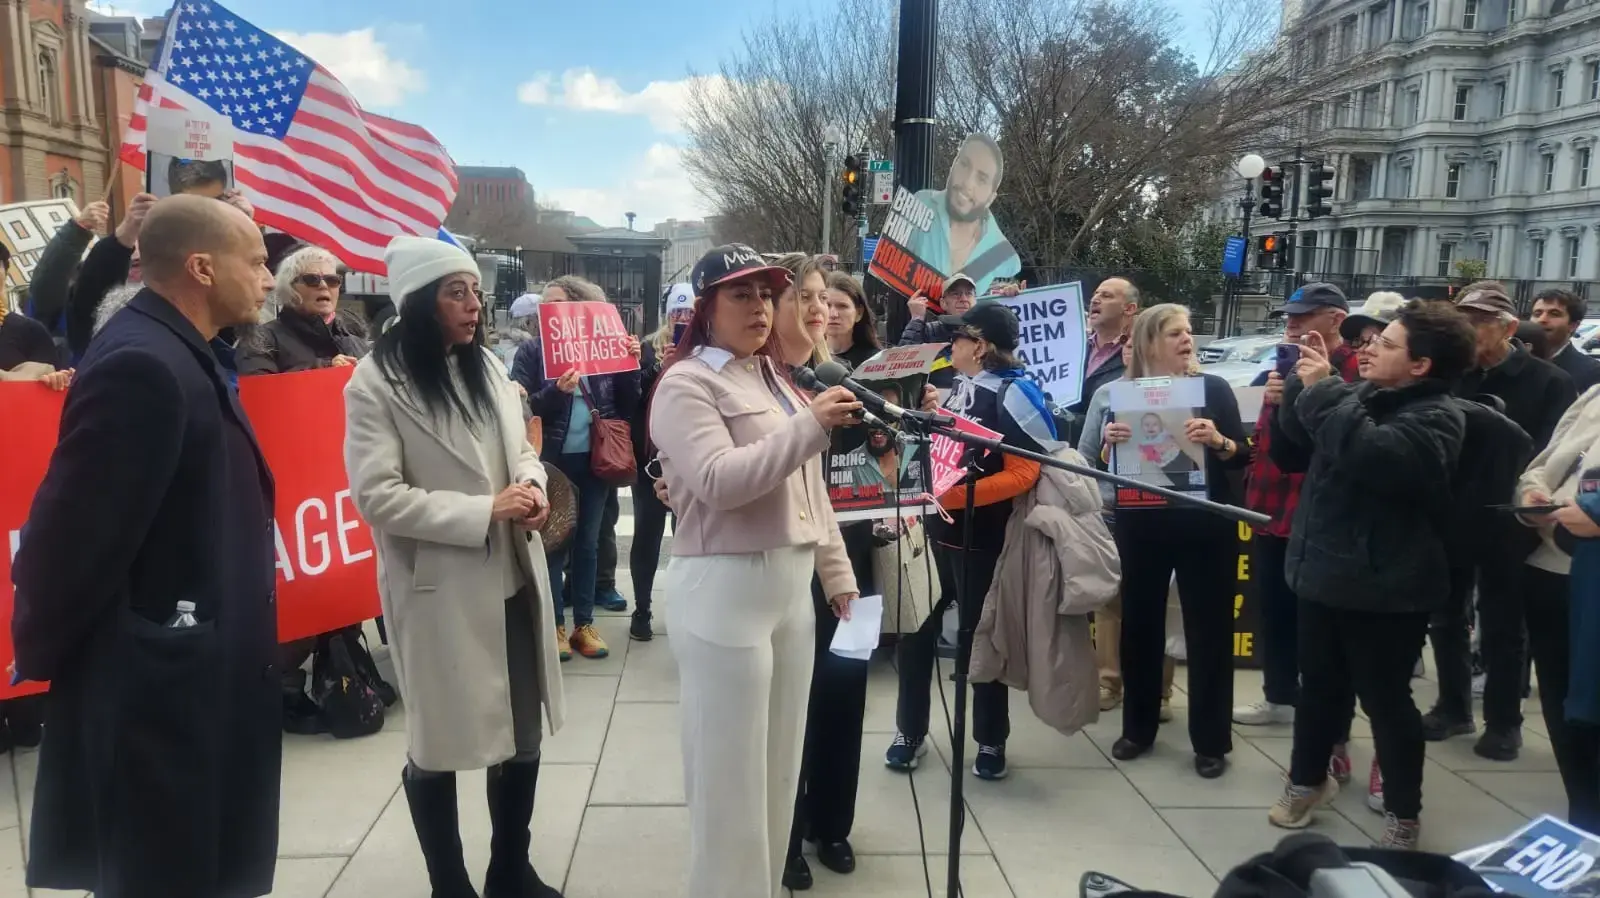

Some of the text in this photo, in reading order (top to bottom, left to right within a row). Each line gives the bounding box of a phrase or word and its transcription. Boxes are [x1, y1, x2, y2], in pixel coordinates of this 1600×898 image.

[873, 161, 883, 170] 17
[893, 187, 934, 232] BRING
[883, 211, 913, 248] HIM
[875, 238, 914, 283] HOME
[1008, 298, 1067, 322] RING
[548, 313, 624, 341] SAVE ALL
[1019, 321, 1065, 344] HEM
[551, 336, 629, 365] HOSTAGES
[1017, 346, 1054, 366] ALL
[831, 452, 866, 468] BRING
[830, 470, 854, 485] HIM
[1503, 834, 1595, 890] END
